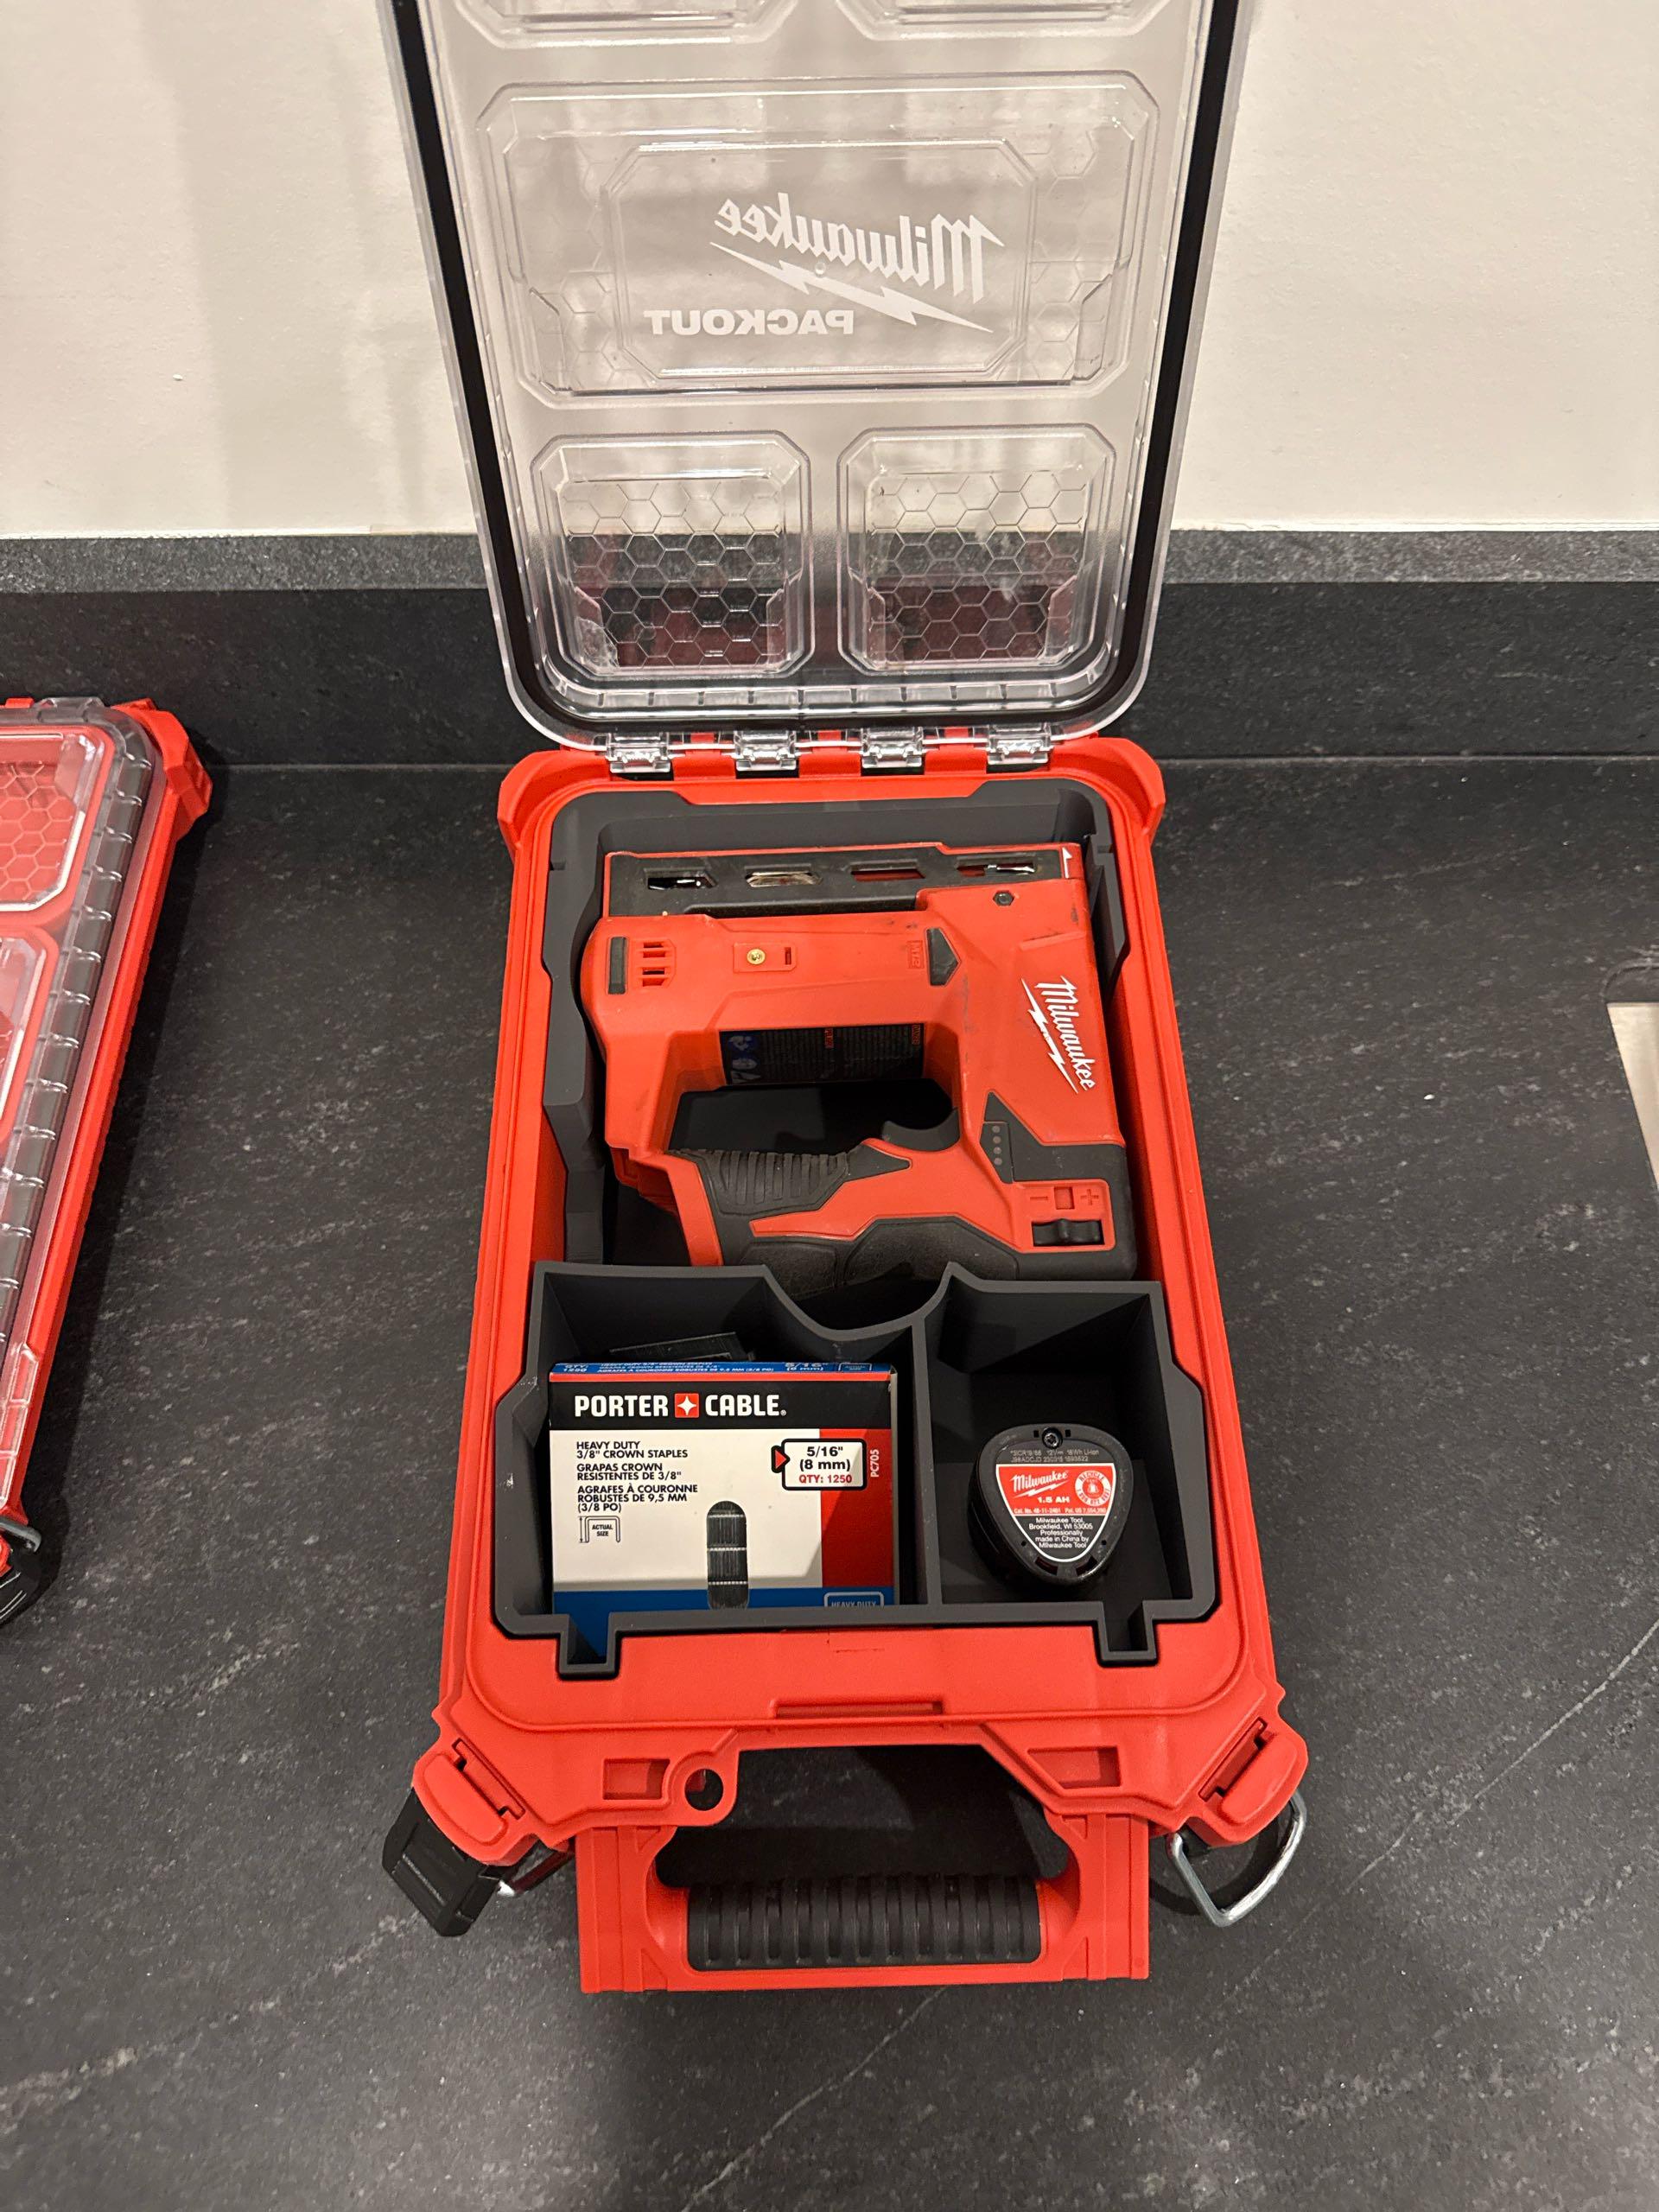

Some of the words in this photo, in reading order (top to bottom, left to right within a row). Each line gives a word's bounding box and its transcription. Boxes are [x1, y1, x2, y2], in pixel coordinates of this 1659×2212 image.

[1034, 976, 1096, 1090] Milwaukee
[575, 1395, 669, 1417] PORTER
[576, 1450, 600, 1459] 3/8"
[603, 1450, 644, 1459] CROWN
[807, 1446, 843, 1458] 5/16"
[621, 1463, 662, 1471] CROWN
[800, 1459, 814, 1471] (8
[818, 1459, 850, 1471] mm)
[870, 1449, 880, 1478] PC705
[658, 1471, 681, 1480] 3/8"
[799, 1474, 823, 1484] QTY:
[828, 1474, 852, 1484] 1250
[1009, 1471, 1067, 1492] Milwaukee
[627, 1483, 634, 1493] À
[578, 1494, 629, 1503] ROBUSTES
[648, 1493, 664, 1503] 9,5
[578, 1503, 600, 1513] (3/8
[603, 1503, 621, 1512] PO)
